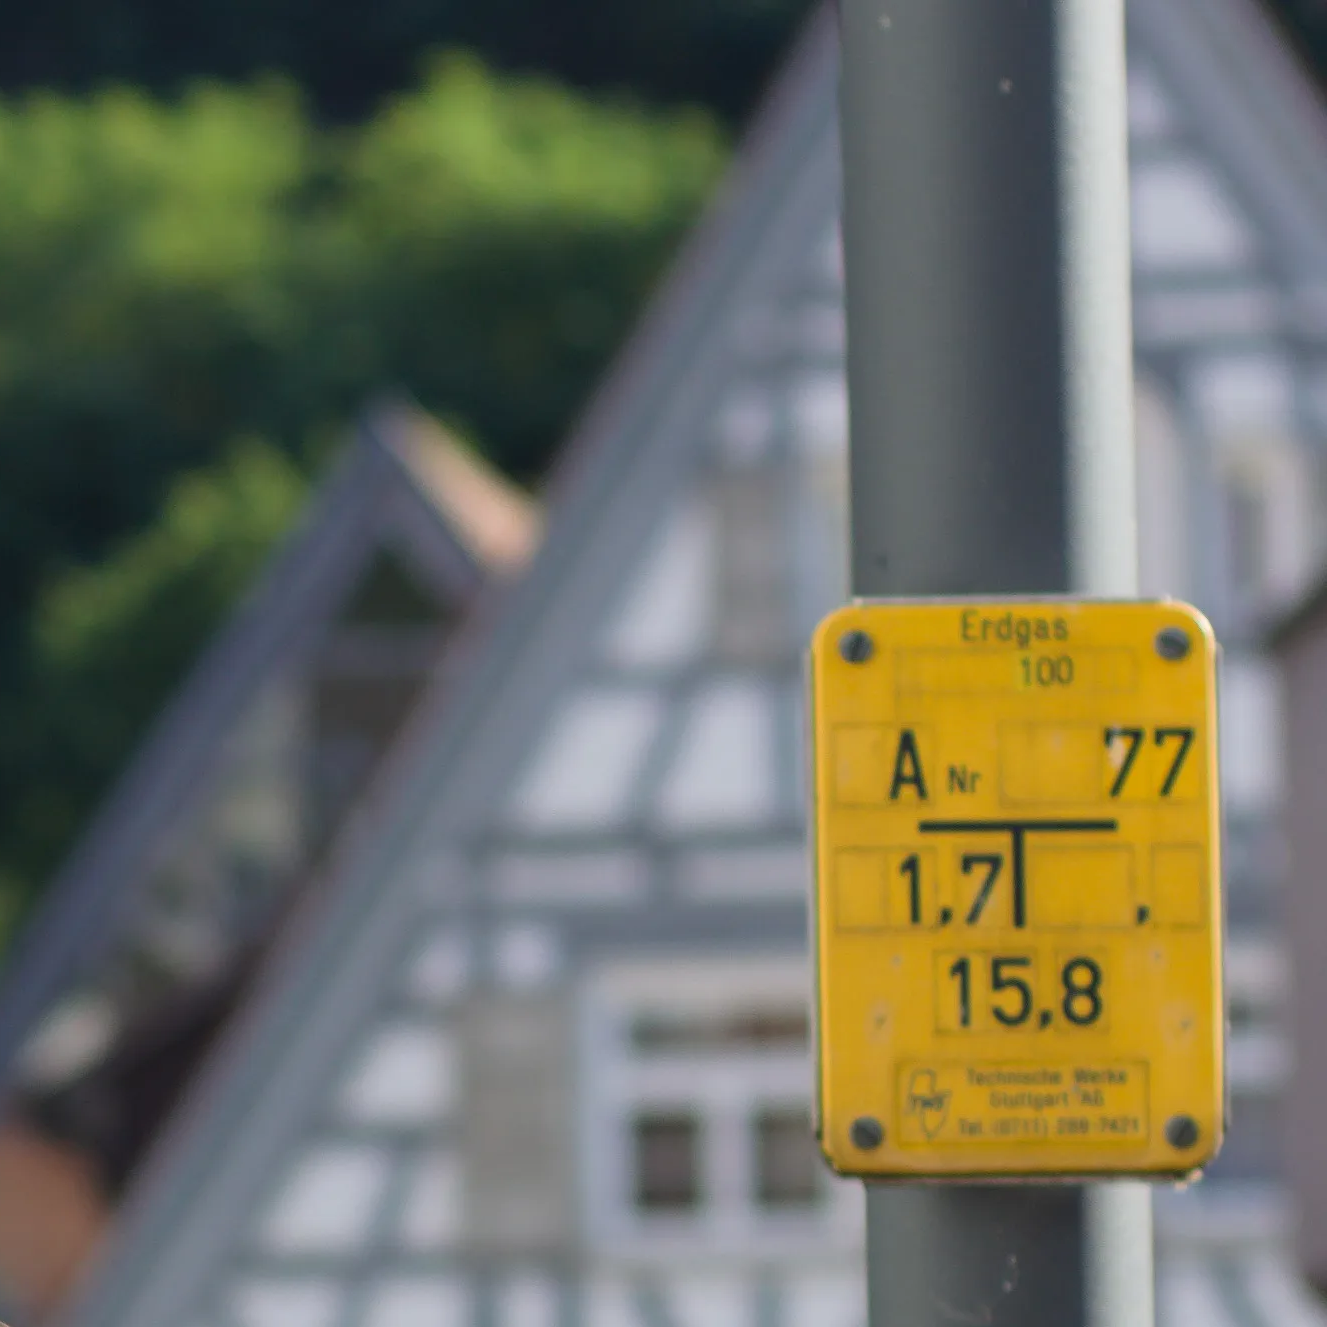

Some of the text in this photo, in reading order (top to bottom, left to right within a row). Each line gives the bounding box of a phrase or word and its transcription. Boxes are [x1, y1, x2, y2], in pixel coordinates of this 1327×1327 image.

[960, 609, 1069, 645] Erdgas
[1020, 655, 1074, 686] 100
[889, 727, 1195, 801] A Nr 77
[949, 957, 1103, 1028] 15,8
[967, 1068, 1127, 1086] Technische Werke
[989, 1090, 1069, 1111] Stuttgart
